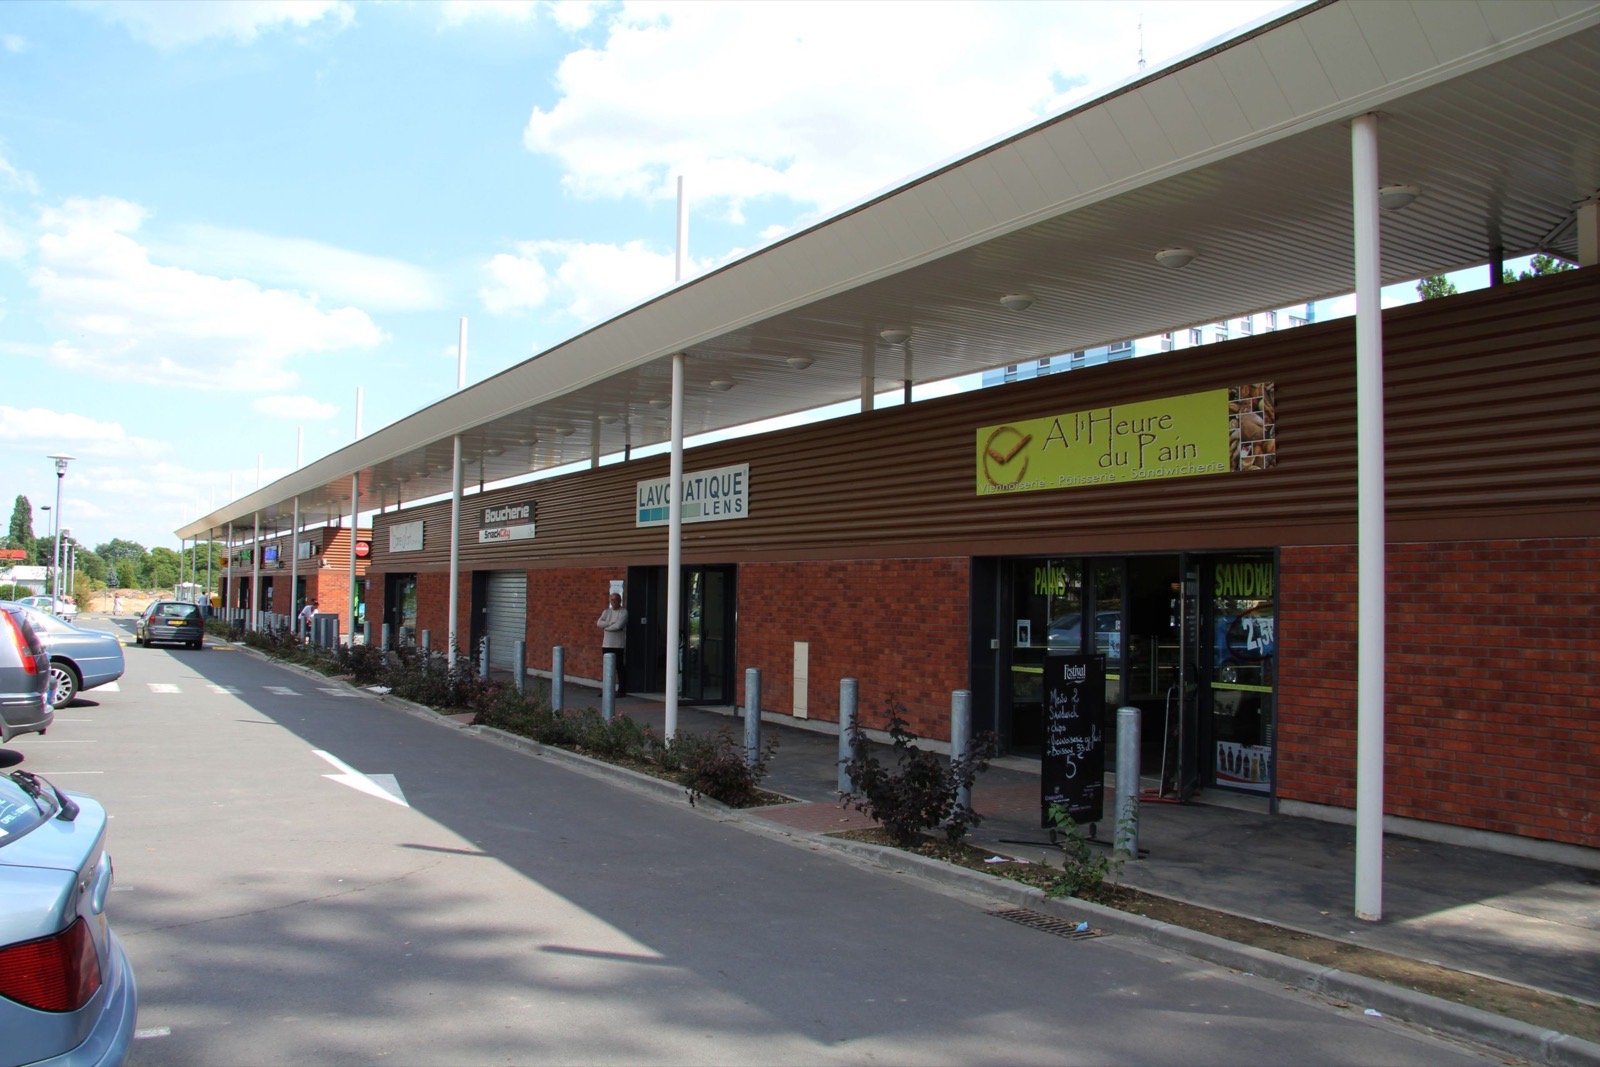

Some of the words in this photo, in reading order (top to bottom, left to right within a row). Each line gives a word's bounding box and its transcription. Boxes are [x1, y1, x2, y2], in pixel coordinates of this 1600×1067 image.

[1098, 433, 1128, 468] du
[1138, 433, 1197, 469] Pain
[1130, 460, 1224, 480] Sandwicherie
[639, 471, 743, 508] LAVOATIQUE
[484, 504, 530, 523] Boucherie
[703, 498, 742, 516] LENS
